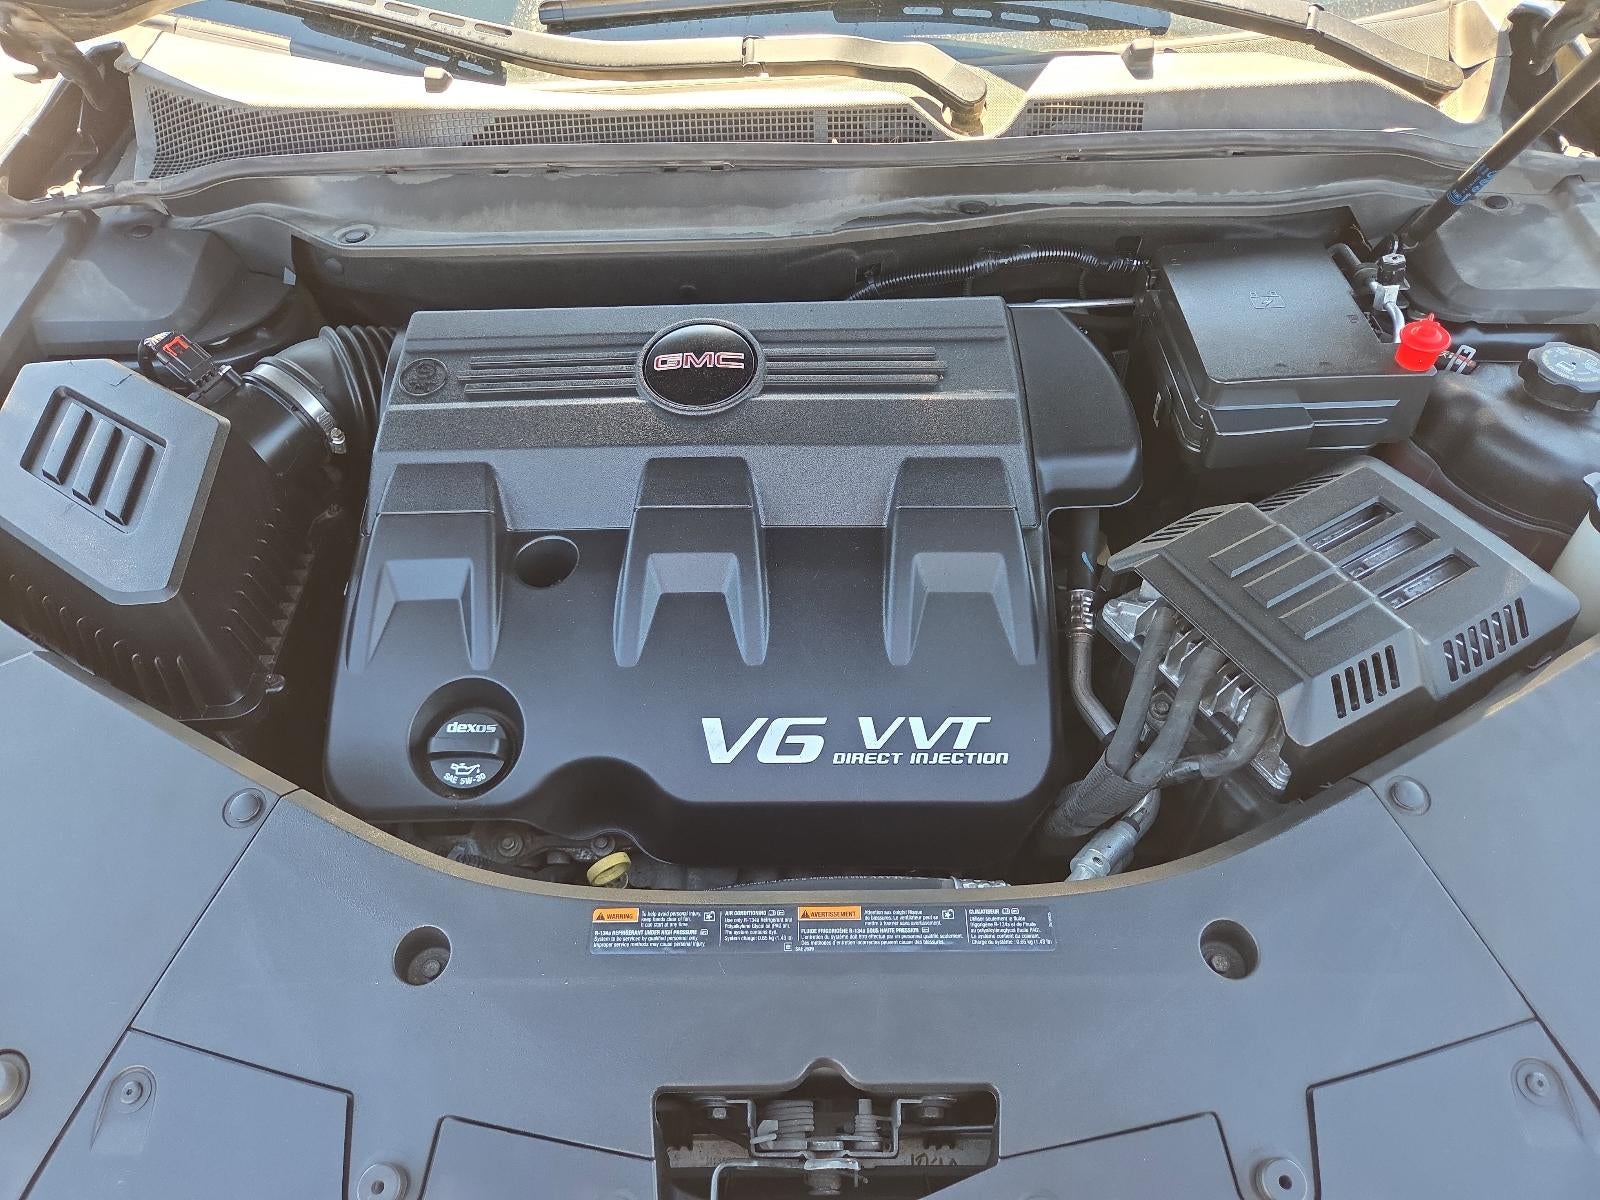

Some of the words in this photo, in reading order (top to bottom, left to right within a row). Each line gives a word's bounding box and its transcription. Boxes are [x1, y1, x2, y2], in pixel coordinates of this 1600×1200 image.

[654, 352, 744, 371] GMC
[446, 721, 499, 733] dexos
[701, 717, 828, 764] V6
[858, 716, 991, 749] VVT
[832, 752, 904, 765] DIRECT
[909, 752, 1009, 765] INJECTION
[443, 772, 458, 784] SAE
[460, 772, 486, 785] 5W-30
